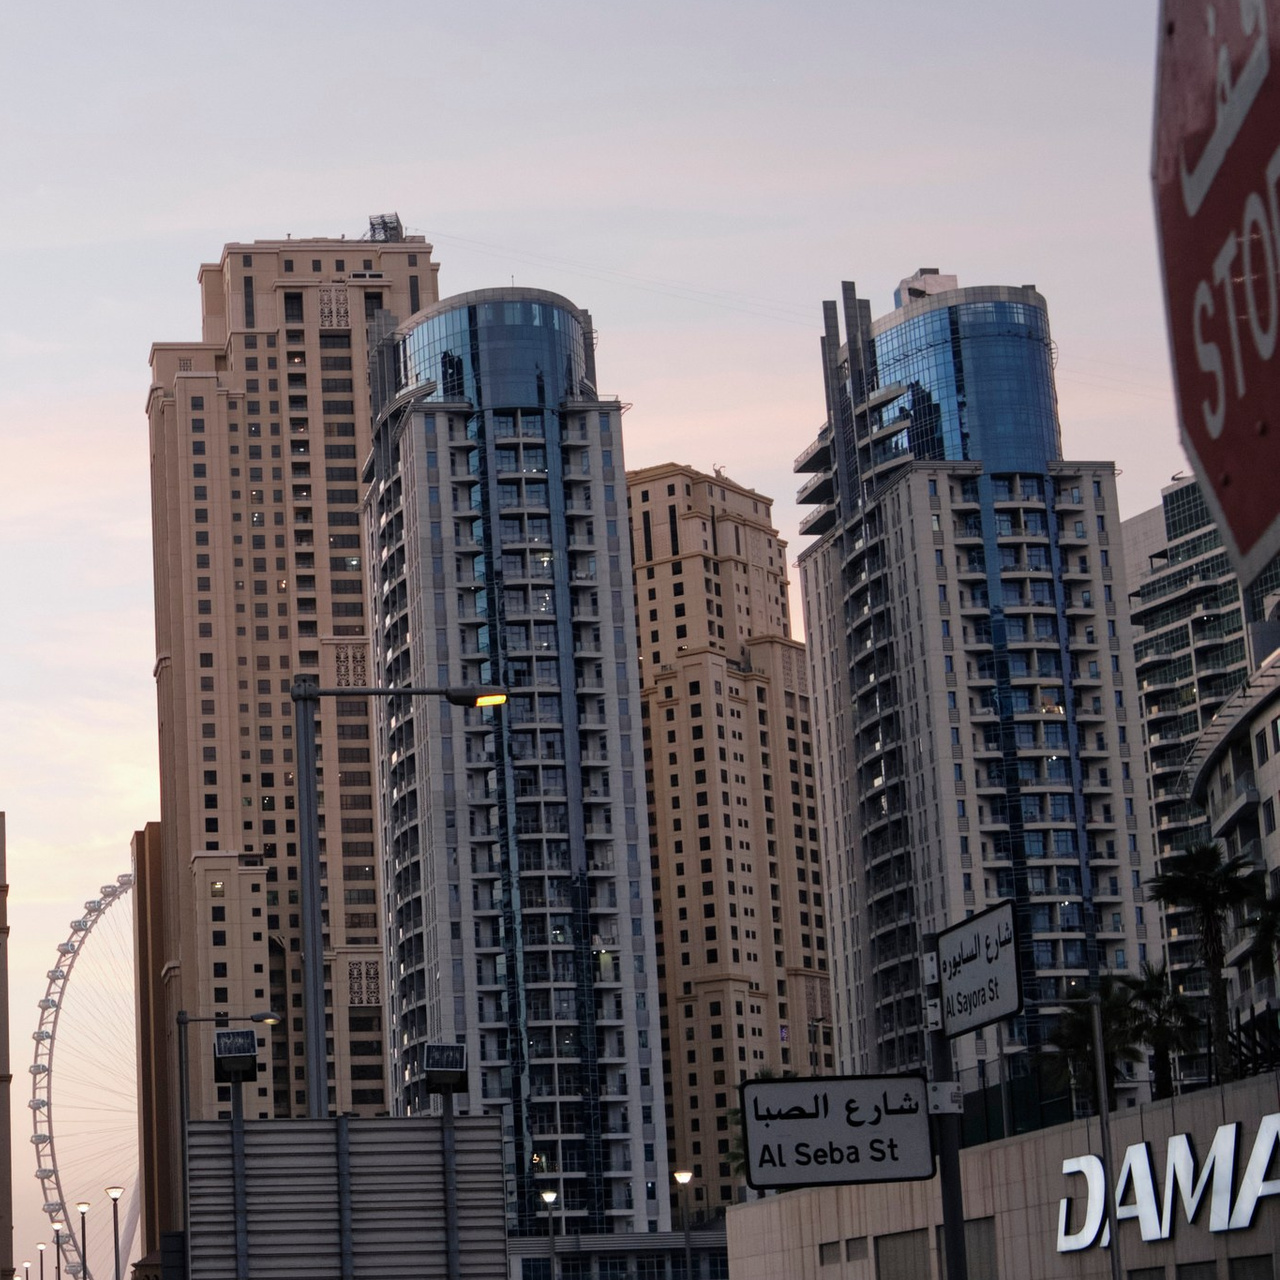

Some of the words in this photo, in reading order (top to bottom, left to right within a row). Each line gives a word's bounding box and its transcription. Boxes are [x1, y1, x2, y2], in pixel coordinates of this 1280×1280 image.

[985, 922, 1012, 964] شارع
[946, 994, 956, 1019] Al
[957, 986, 986, 1016] Sayora
[988, 977, 999, 1002] St
[753, 1092, 829, 1128] الصبا
[845, 1091, 919, 1127] شارع
[758, 1143, 787, 1168] Al
[794, 1141, 860, 1166] Seba
[870, 1138, 899, 1162] St
